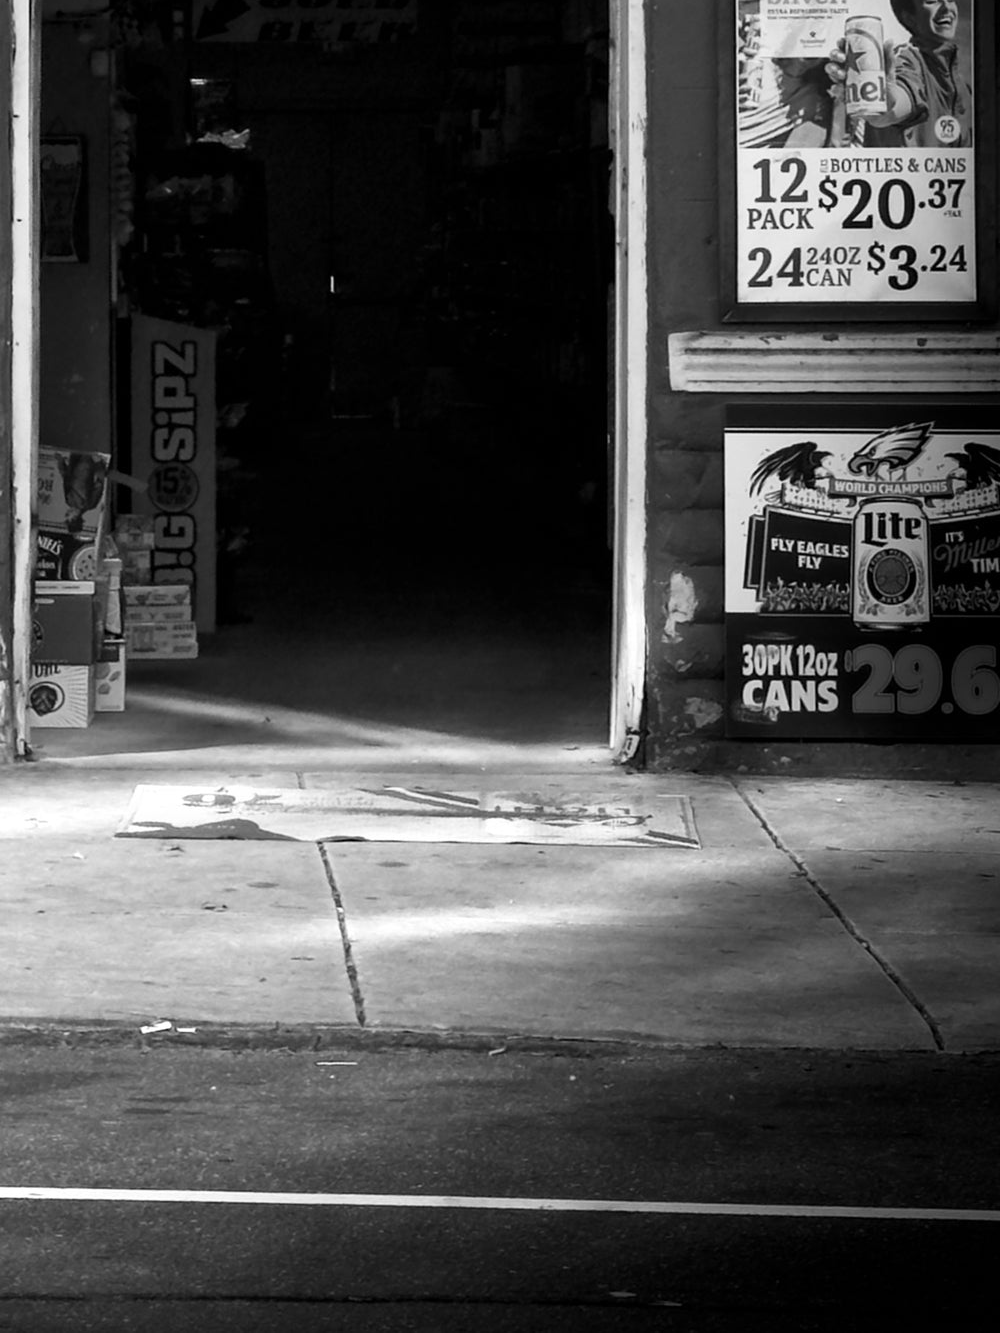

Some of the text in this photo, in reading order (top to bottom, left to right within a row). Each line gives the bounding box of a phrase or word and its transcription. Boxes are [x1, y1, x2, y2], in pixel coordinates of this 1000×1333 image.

[939, 119, 955, 133] 95
[829, 157, 904, 173] BOTTLES
[907, 157, 920, 173] &
[923, 157, 967, 173] CANS
[752, 157, 809, 203] 12
[818, 175, 966, 230] $20.37
[746, 207, 814, 230] PACK
[747, 247, 805, 288] 24
[805, 268, 853, 287] CAN
[866, 241, 968, 291] $3.24
[835, 480, 948, 495] WORLD CHAMPIONS
[861, 512, 923, 548] Lite
[770, 537, 849, 558] FLY EAGLES
[797, 555, 823, 570] FLY
[741, 644, 793, 677] 30PK
[742, 680, 839, 713] CANS
